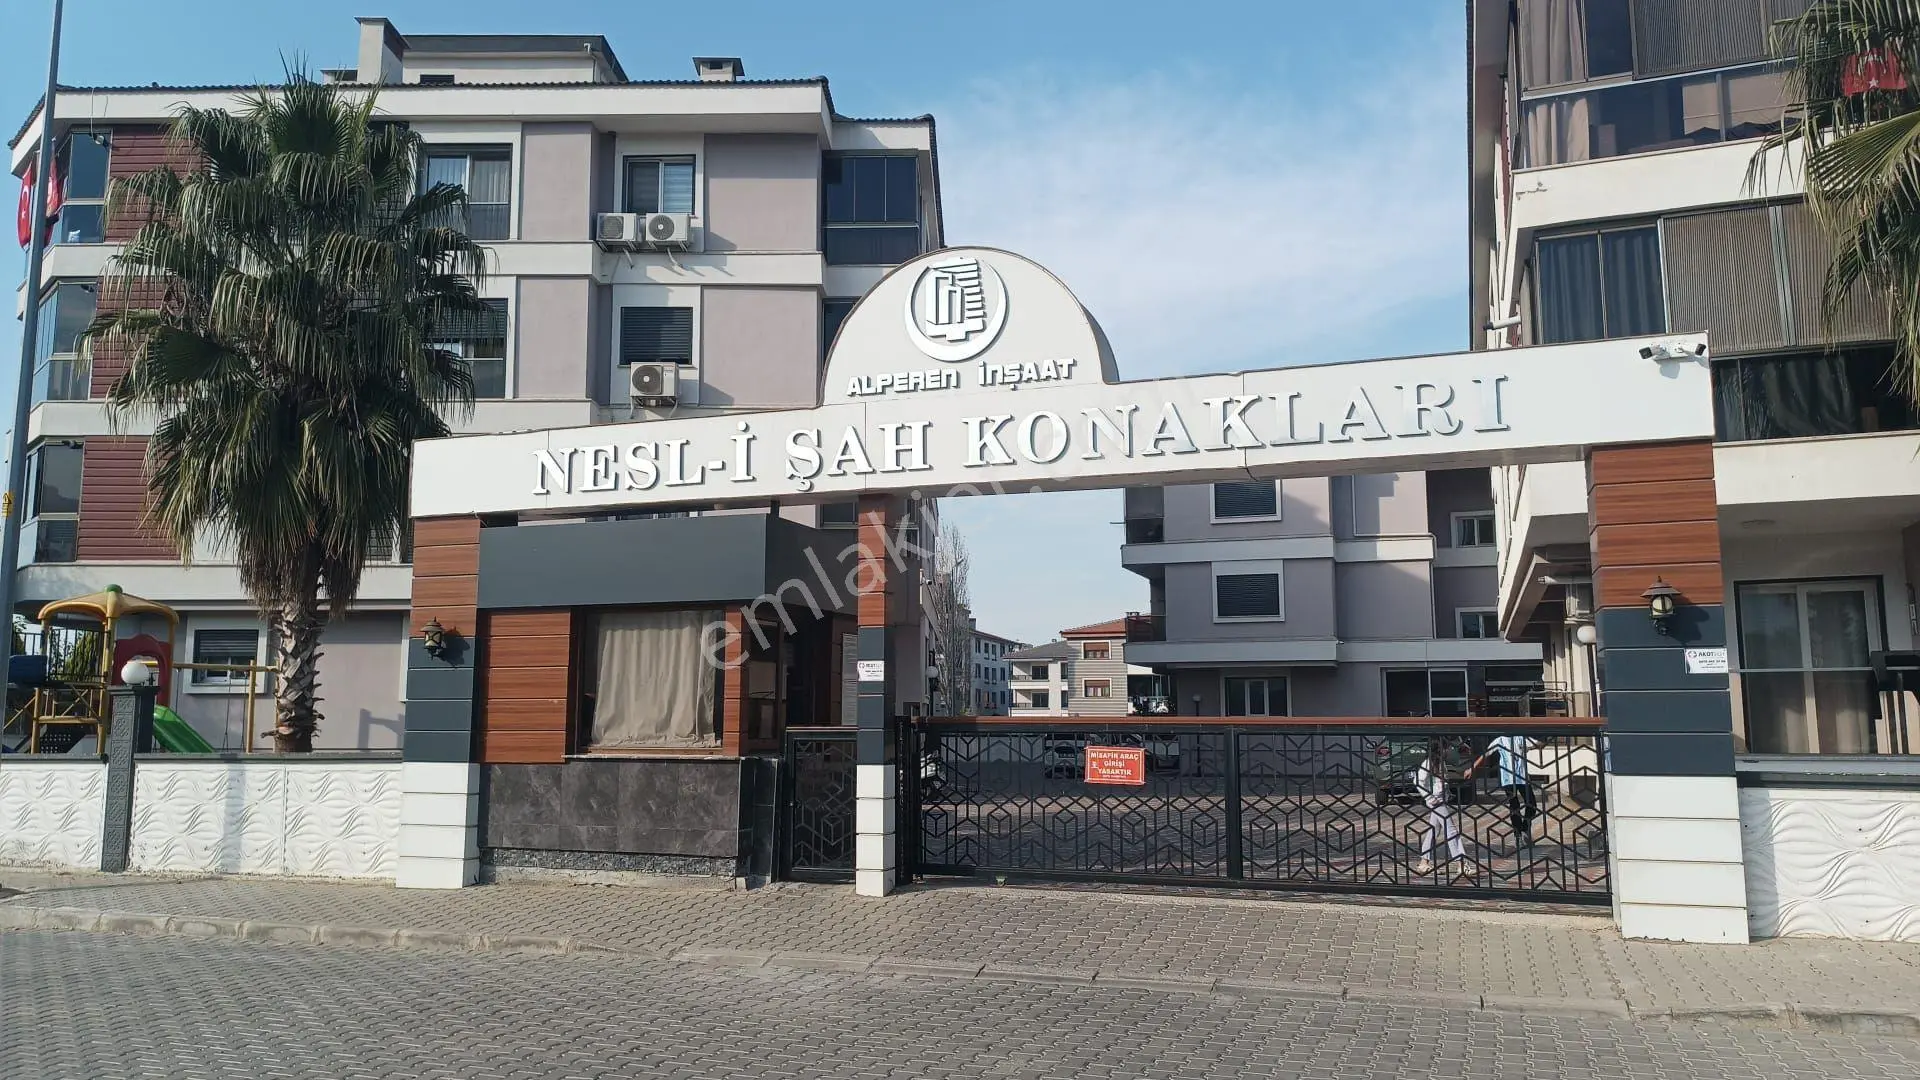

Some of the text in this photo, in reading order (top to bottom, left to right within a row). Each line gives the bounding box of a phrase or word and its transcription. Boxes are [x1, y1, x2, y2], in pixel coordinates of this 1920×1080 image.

[847, 368, 960, 397] ALPEREN
[532, 374, 1512, 496] NESL-İ ŞAH KONAKLARI
[1098, 768, 1132, 776] YASAKTIR
[1104, 760, 1125, 768] GİRİŞİ
